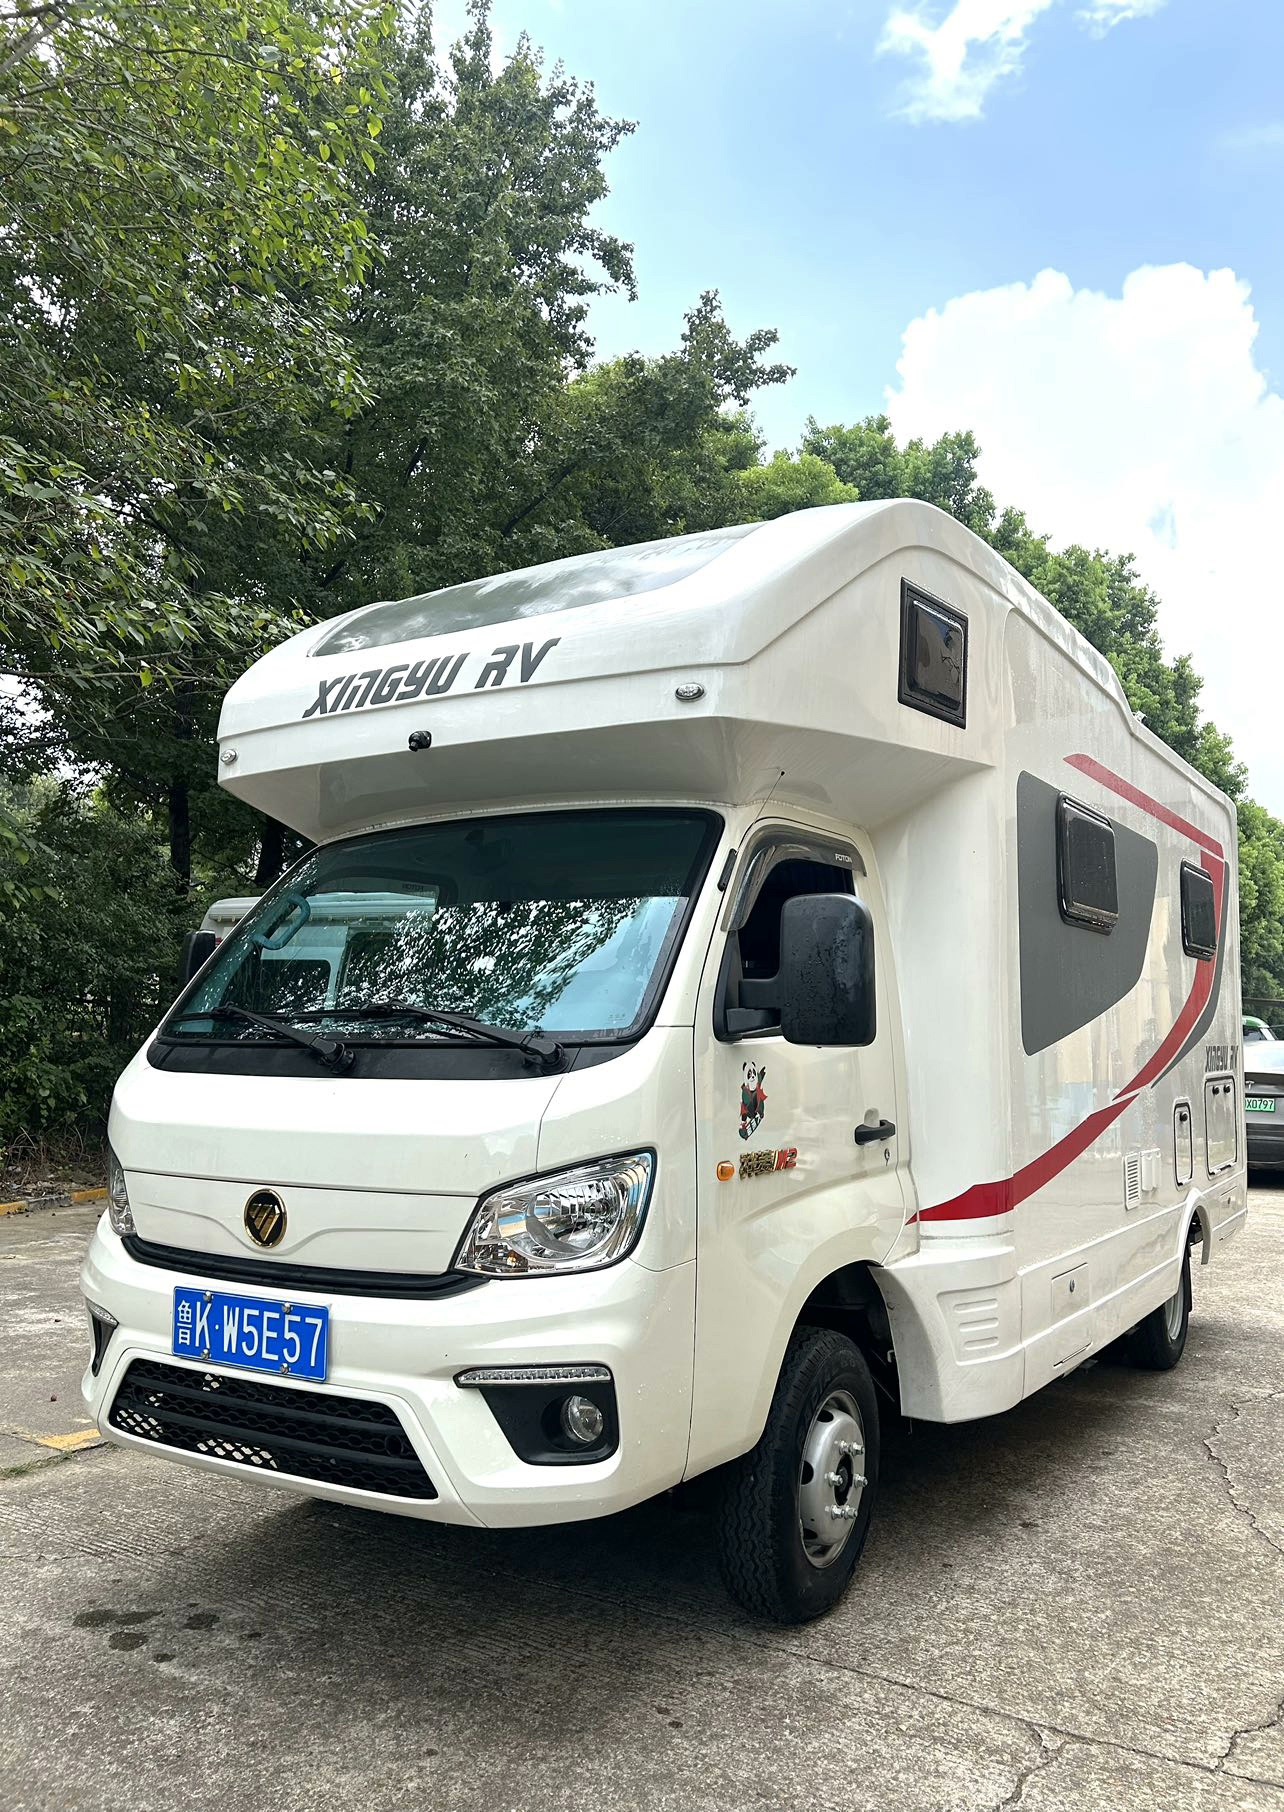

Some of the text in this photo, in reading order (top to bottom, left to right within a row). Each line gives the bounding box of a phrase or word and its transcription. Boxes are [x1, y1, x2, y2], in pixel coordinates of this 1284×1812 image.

[302, 637, 561, 719] XINGYU RV
[1245, 1098, 1274, 1110] X0797
